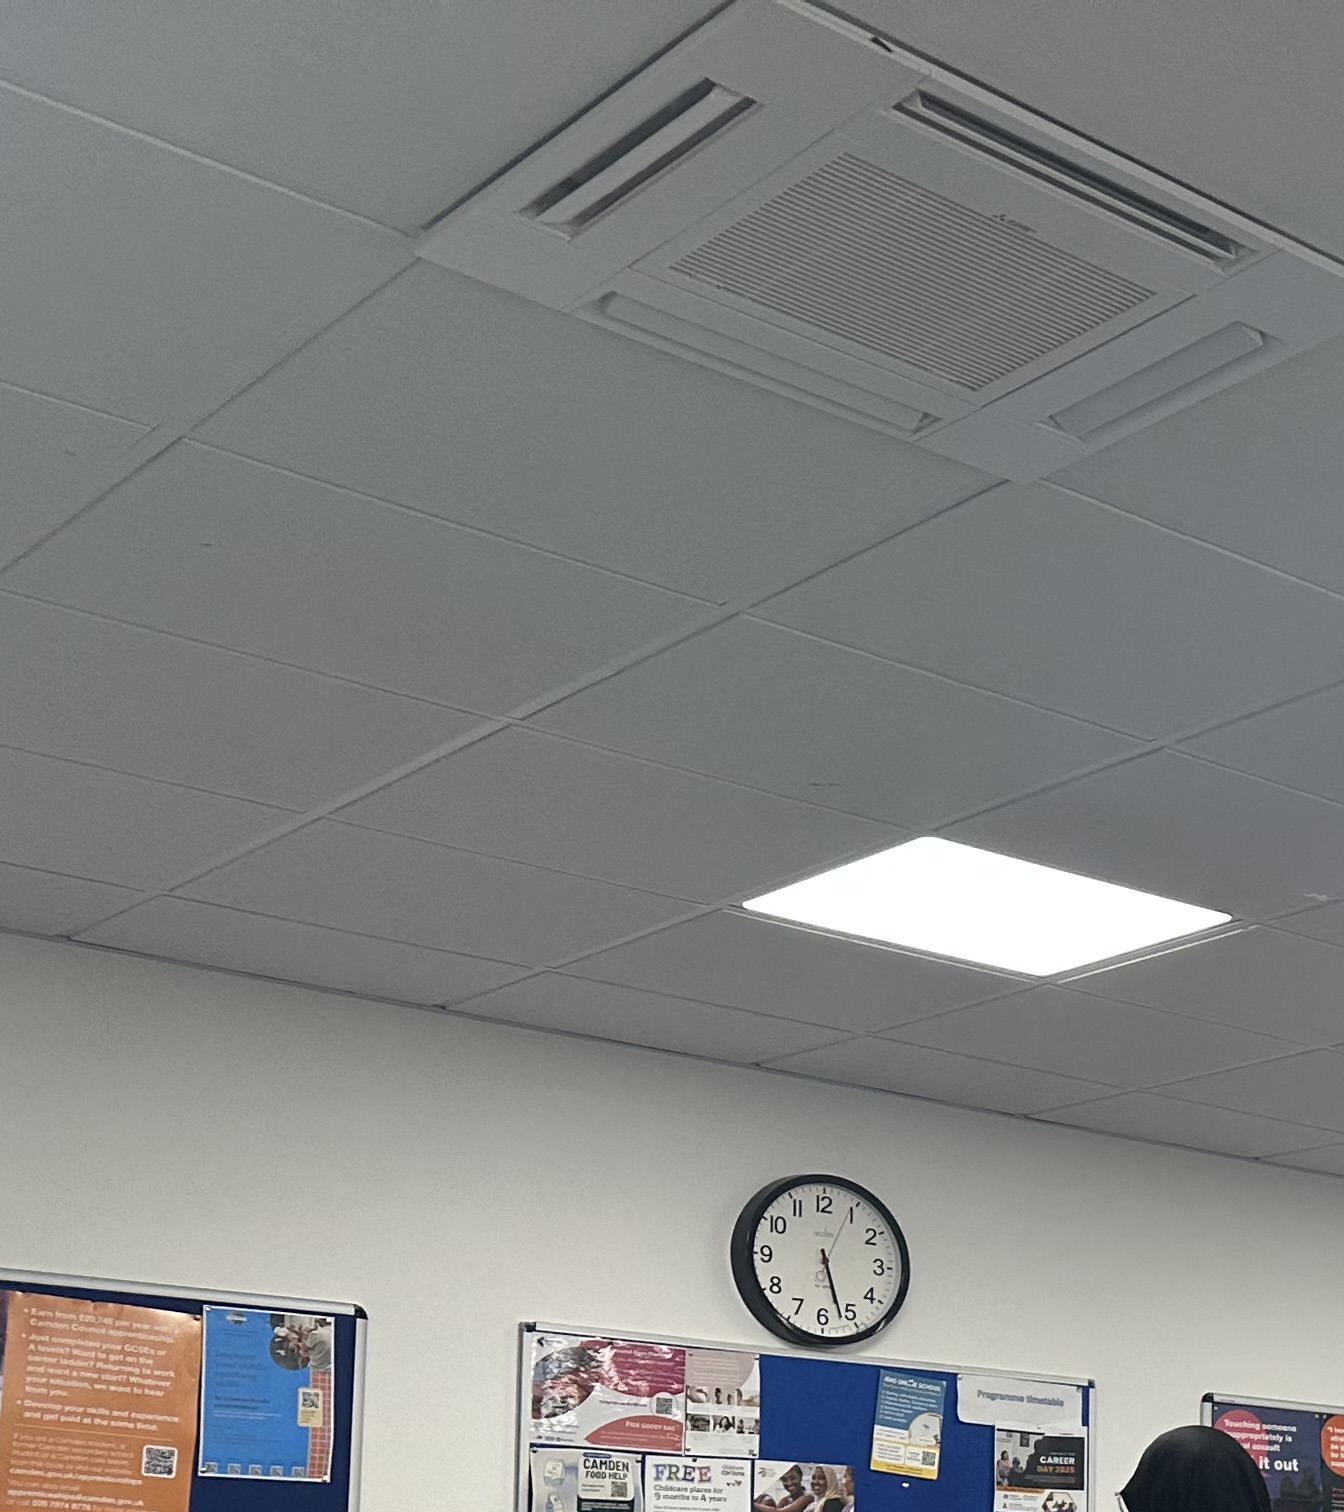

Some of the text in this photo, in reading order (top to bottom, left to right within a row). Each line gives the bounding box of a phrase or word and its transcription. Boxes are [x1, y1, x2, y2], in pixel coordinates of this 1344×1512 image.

[793, 1199, 802, 1217] 11
[816, 1195, 832, 1214] 12
[770, 1215, 786, 1234] 10
[865, 1228, 877, 1246] 2
[760, 1245, 772, 1263] 9
[873, 1259, 885, 1276] 3
[770, 1276, 782, 1294] 8
[863, 1287, 875, 1304] 4
[792, 1298, 804, 1315] 7
[845, 1303, 856, 1320] 5
[817, 1308, 829, 1326] 6
[977, 1389, 1065, 1407] Programme timetable
[1224, 1419, 1296, 1432] Touching someone
[1285, 1434, 1292, 1442] is
[584, 1459, 629, 1472] CAMDEN
[1040, 1456, 1075, 1464] CAREER
[1259, 1456, 1299, 1472] it out
[585, 1470, 628, 1480] FOOD HELP
[653, 1463, 712, 1483] FREE
[653, 1484, 688, 1492] Childcare
[654, 1492, 661, 1500] 9
[700, 1494, 706, 1502] 4
